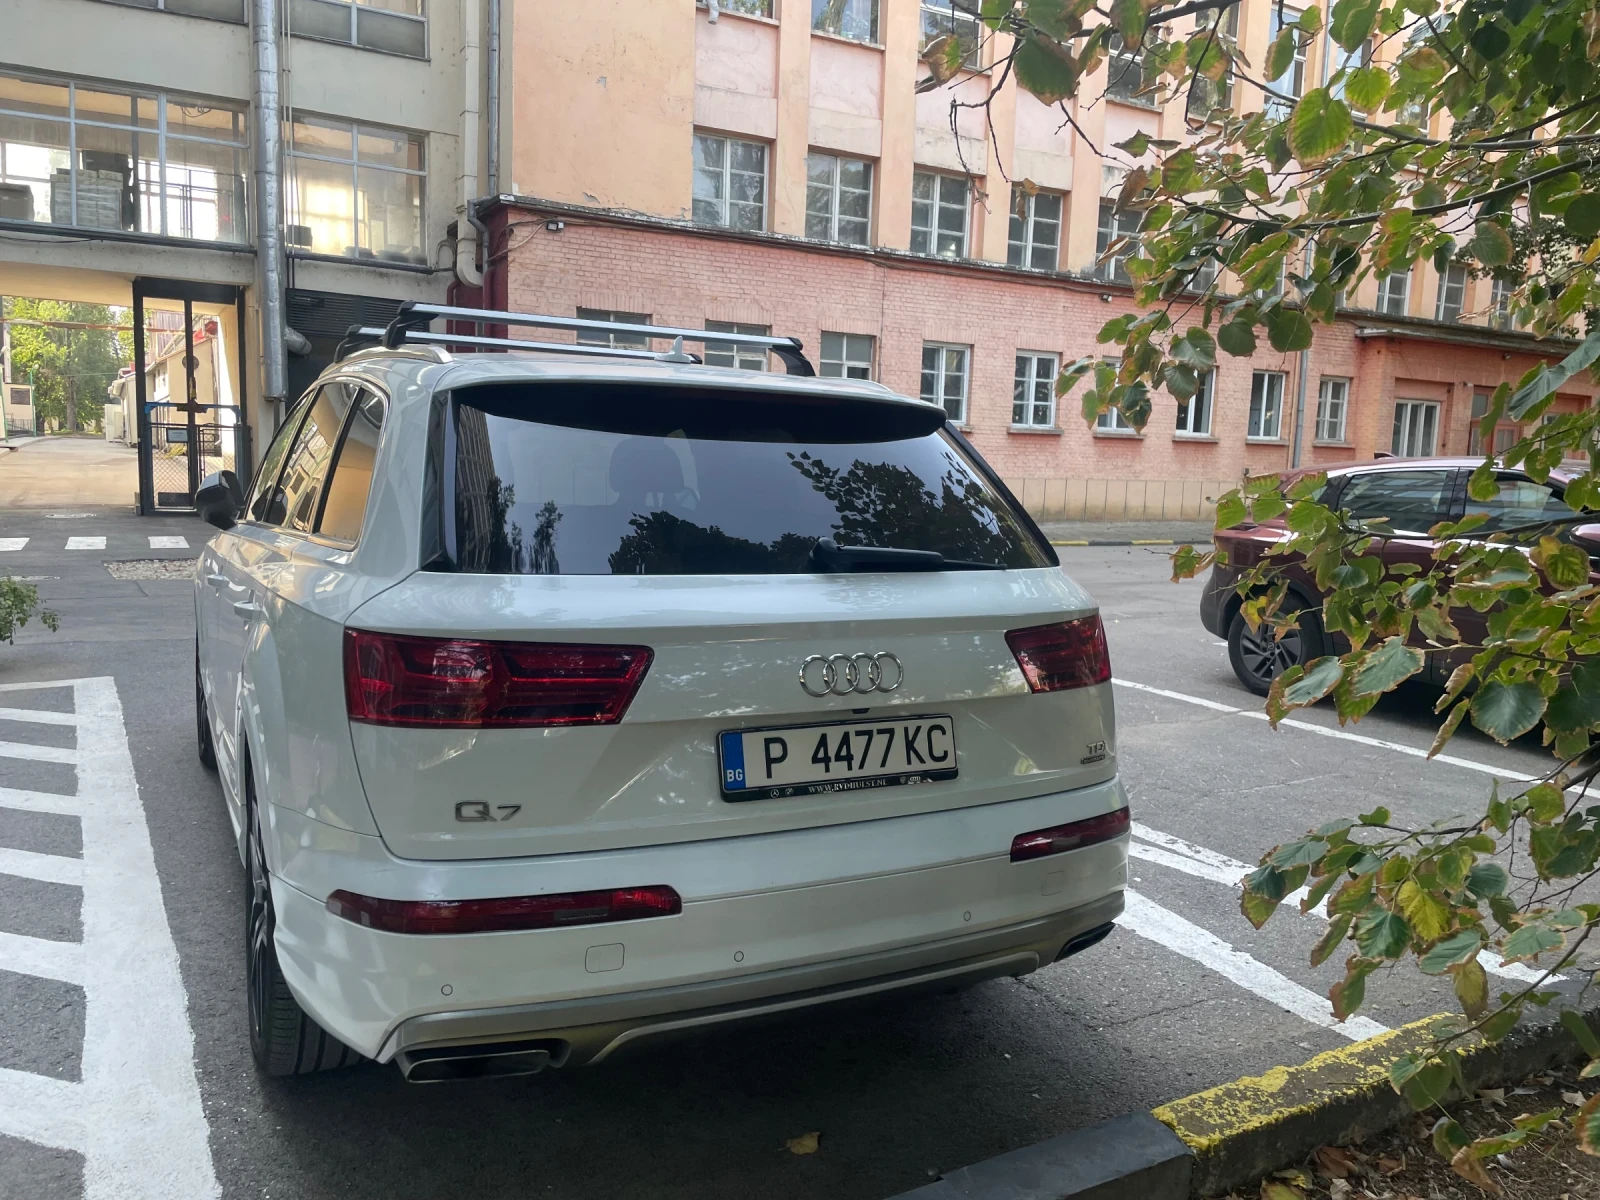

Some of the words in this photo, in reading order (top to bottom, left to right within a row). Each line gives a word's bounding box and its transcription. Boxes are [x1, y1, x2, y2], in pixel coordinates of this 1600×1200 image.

[764, 737, 788, 779] P
[811, 728, 895, 773] 4477
[904, 724, 949, 765] KC
[726, 769, 743, 782] BG
[455, 800, 521, 822] Q7
